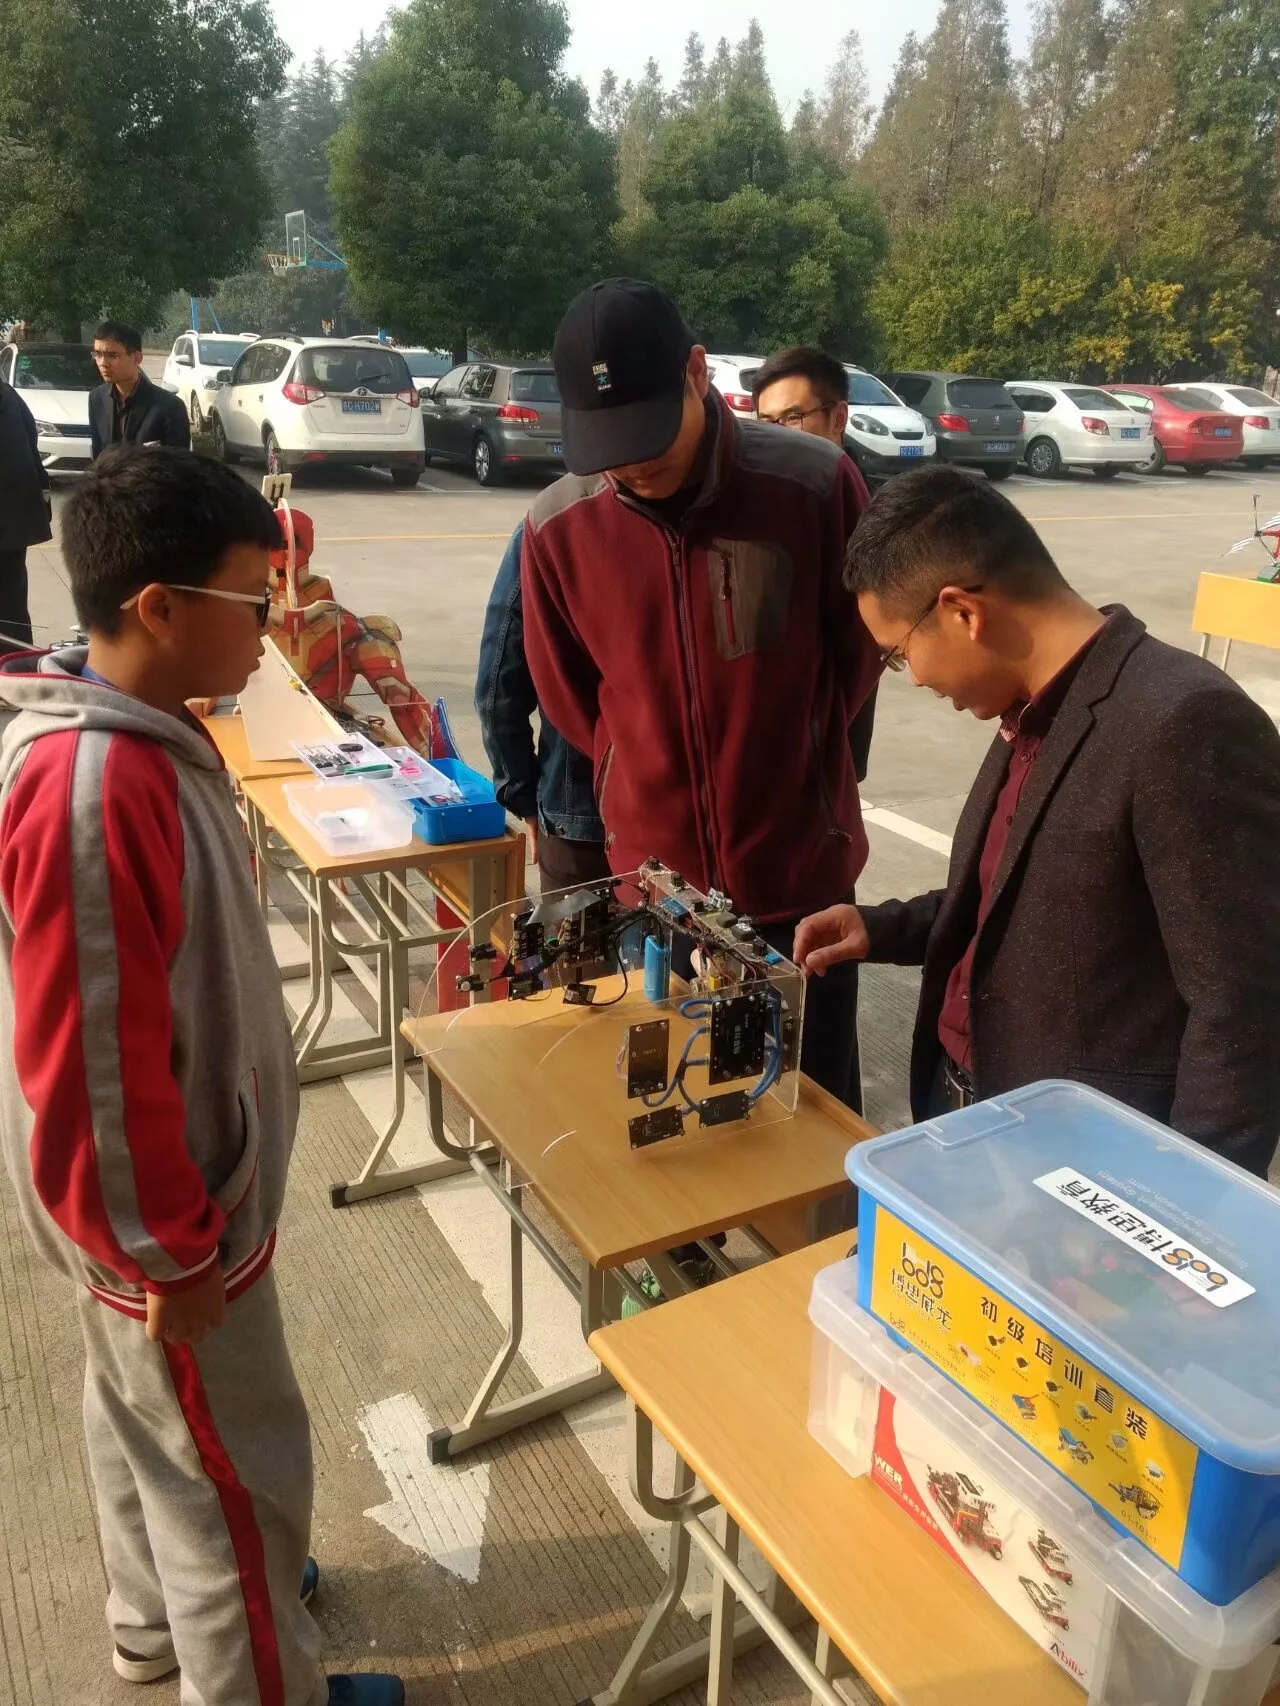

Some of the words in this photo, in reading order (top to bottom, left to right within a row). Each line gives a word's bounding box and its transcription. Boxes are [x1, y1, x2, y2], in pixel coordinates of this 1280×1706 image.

[1056, 1180, 1172, 1252] 博思教育
[980, 1296, 1148, 1440] 初级培训套装
[874, 1453, 903, 1486] WER
[1050, 1642, 1085, 1680] Abilix
